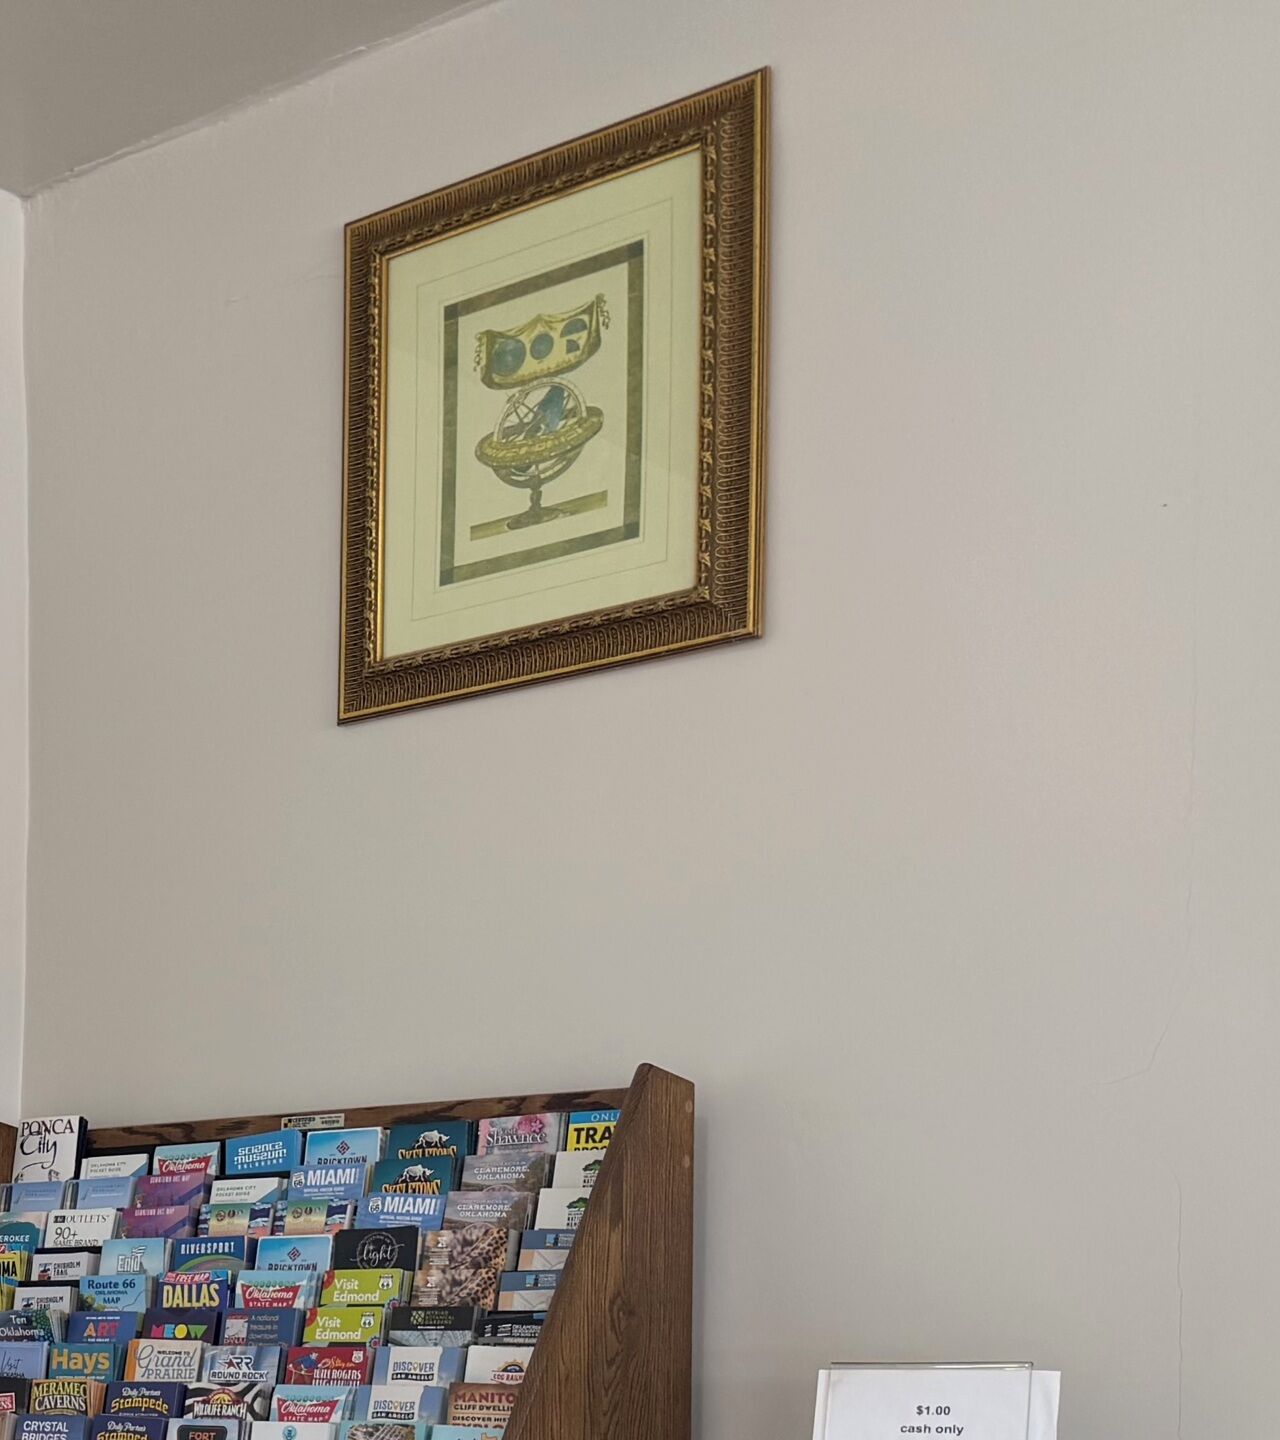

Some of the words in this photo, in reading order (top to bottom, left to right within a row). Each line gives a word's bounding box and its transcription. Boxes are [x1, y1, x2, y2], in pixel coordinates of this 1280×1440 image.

[21, 1118, 75, 1138] PONCA
[574, 1125, 616, 1144] TRA
[486, 1128, 547, 1147] Shawnee
[20, 1132, 59, 1169] City
[161, 1159, 206, 1173] Oklahoma
[65, 1214, 107, 1223] OUTLETS
[55, 1226, 78, 1240] 90+
[181, 1241, 234, 1255] RIVERSPORT
[53, 1261, 81, 1270] CHISHOLM
[88, 1279, 119, 1290] Route
[122, 1278, 136, 1289] 66
[335, 1279, 359, 1290] Visit
[102, 1296, 121, 1304] MAP
[162, 1284, 220, 1309] DALLAS
[245, 1287, 293, 1301] Oklahoma
[334, 1290, 380, 1302] Edmond
[10, 1315, 27, 1325] Ten
[316, 1316, 341, 1328] Visit
[83, 1321, 119, 1337] ART
[151, 1324, 209, 1339] MEOW
[315, 1328, 361, 1340] Edmond
[52, 1348, 110, 1374] Hays
[137, 1344, 195, 1380] Grand
[392, 1361, 434, 1372] DISCOVER
[146, 1368, 195, 1380] PRAIRIE
[211, 1370, 241, 1380] ROUND
[242, 1371, 266, 1380] ROCK
[331, 1369, 361, 1380] ROGERS
[33, 1382, 88, 1398] MERAMEC
[35, 1395, 86, 1411] CAVERNS
[111, 1397, 169, 1415] Stampede
[281, 1400, 330, 1414] Oklahoma
[373, 1400, 415, 1411] DISCOVER
[193, 1402, 221, 1417] WILDLIFE
[221, 1401, 247, 1419] RANCH
[388, 1412, 414, 1420] ANGELO
[916, 1405, 951, 1416] $1.00
[23, 1420, 69, 1433] CRYSTAL
[900, 1424, 931, 1434] cash
[935, 1424, 964, 1437] only
[188, 1431, 216, 1440] FORT
